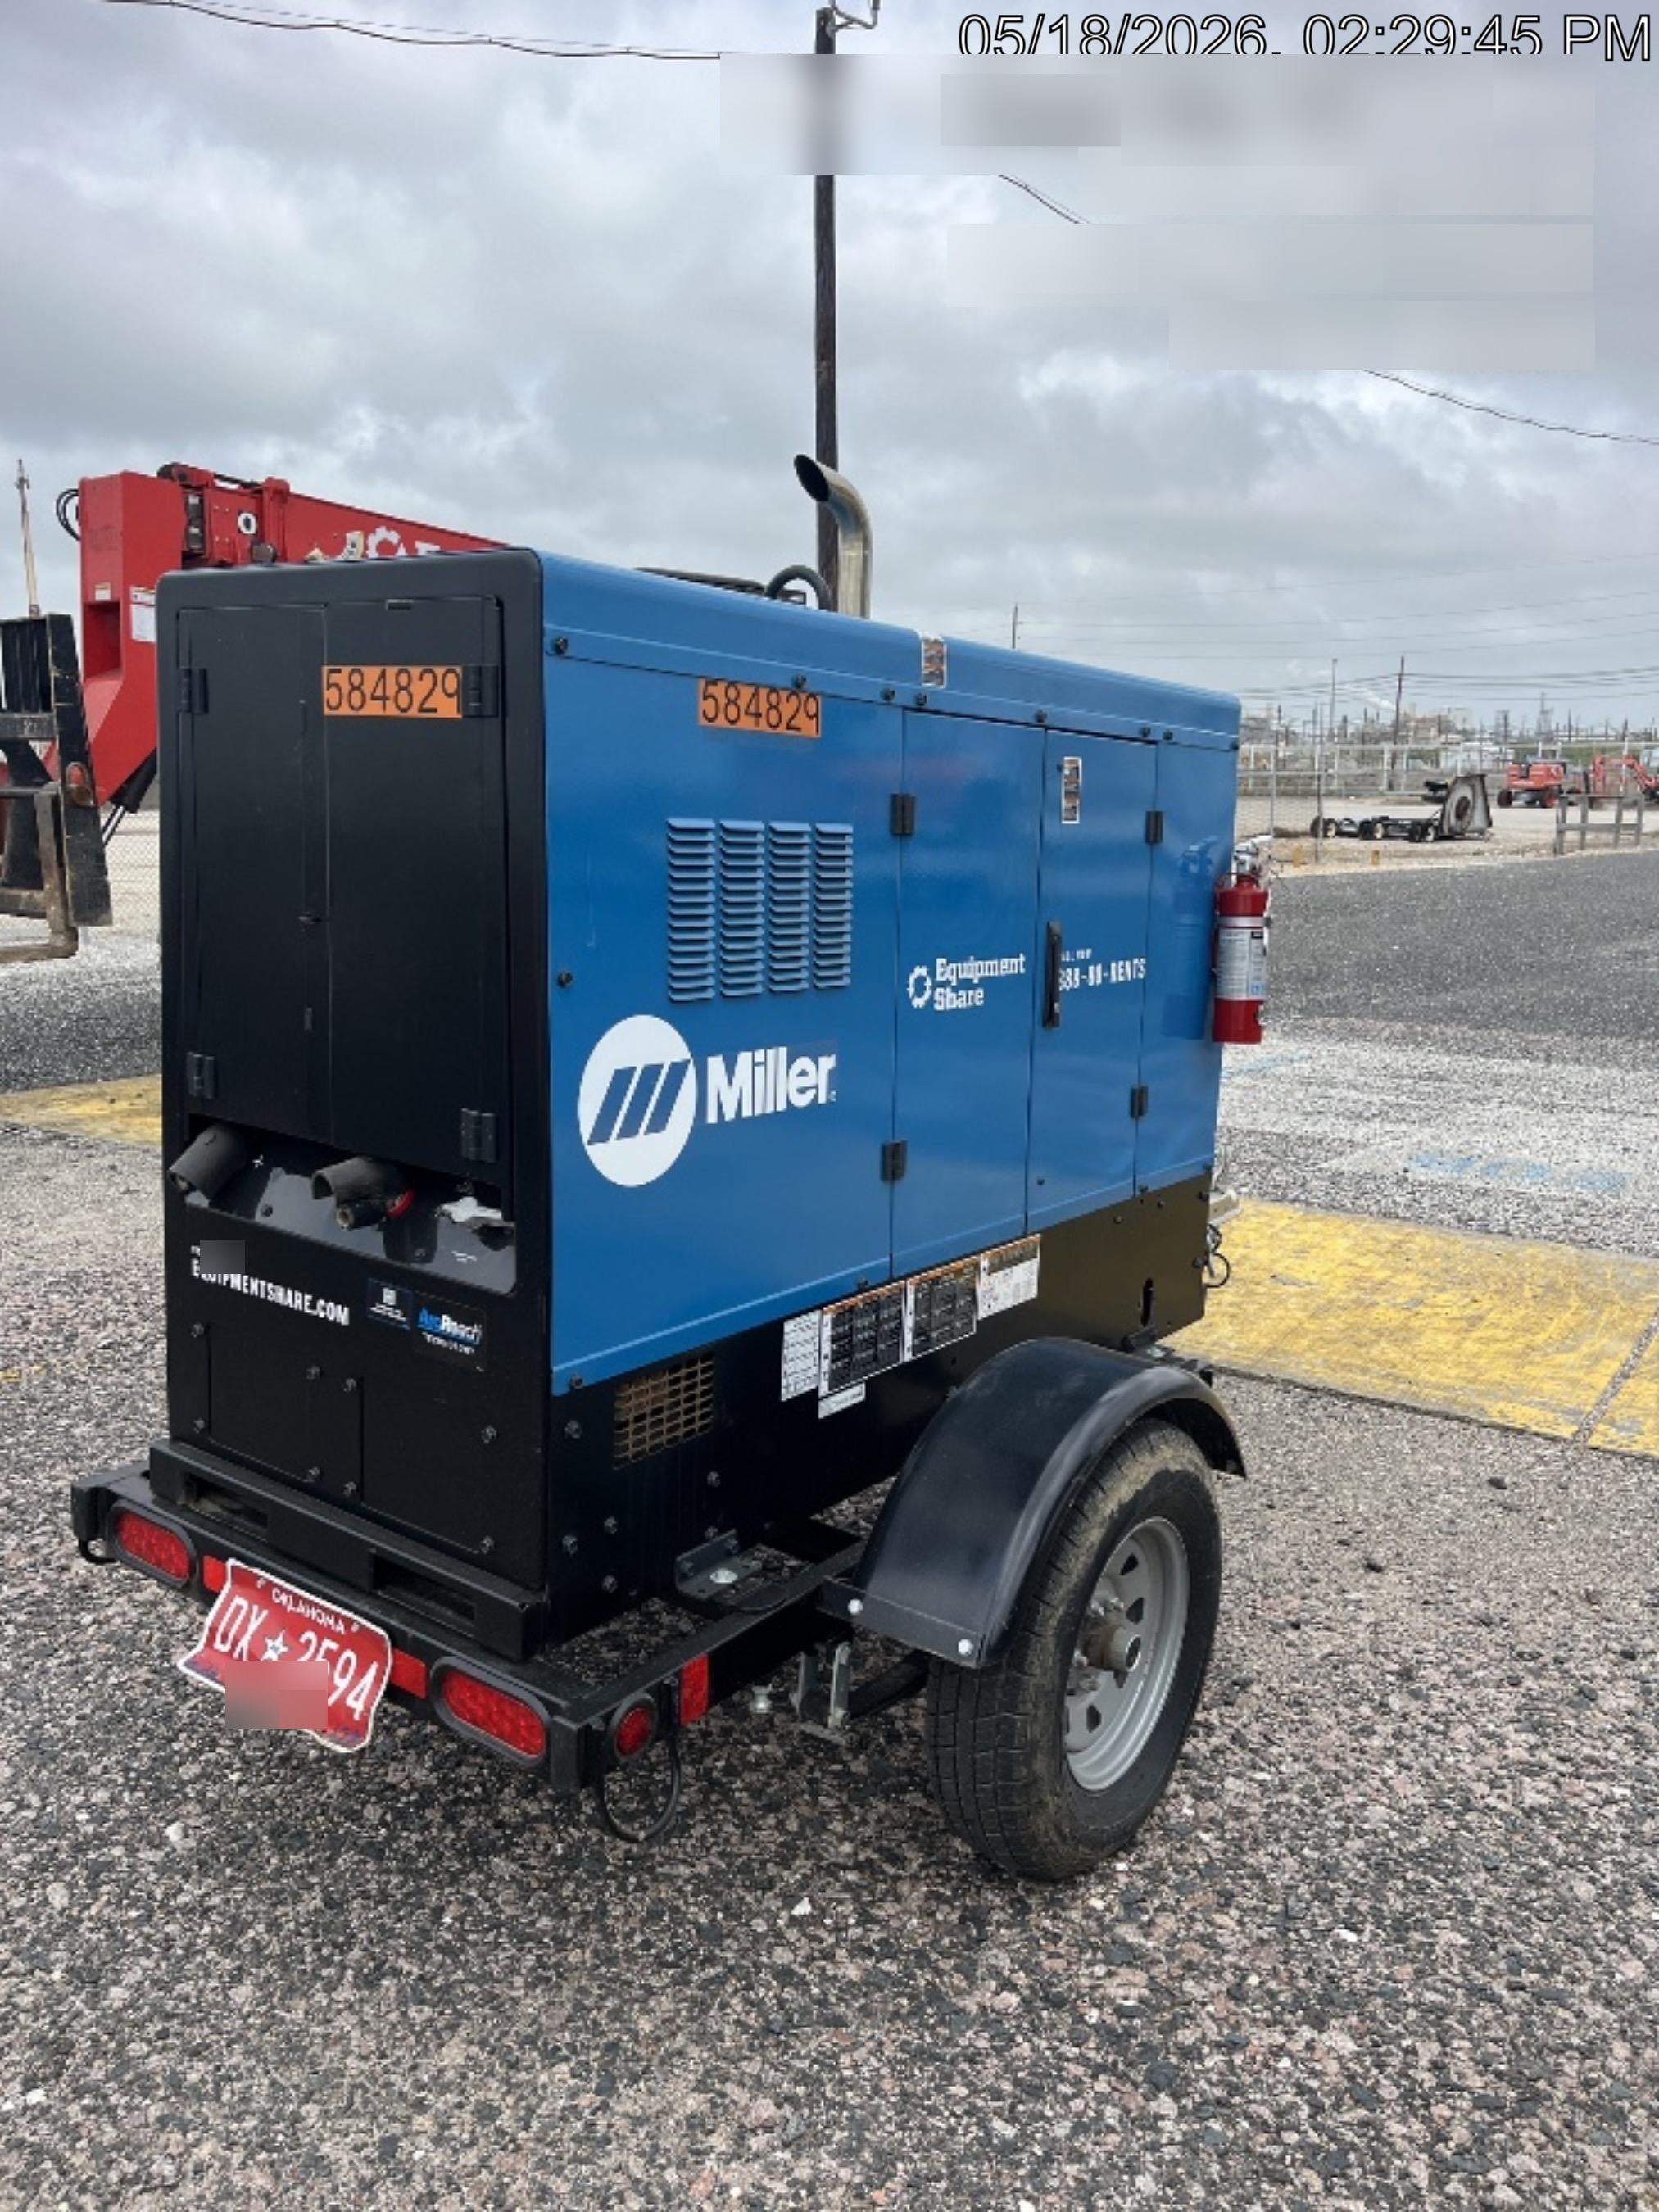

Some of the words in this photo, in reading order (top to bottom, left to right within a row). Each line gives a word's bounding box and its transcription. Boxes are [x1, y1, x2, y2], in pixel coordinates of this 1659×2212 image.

[326, 668, 461, 714] 584829
[702, 680, 819, 735] 584829
[936, 953, 1026, 986] Equipment
[934, 986, 984, 1011] Share
[706, 1046, 836, 1124] Miller
[213, 1594, 269, 1661] DX
[271, 1588, 346, 1635] OKLAHOMA
